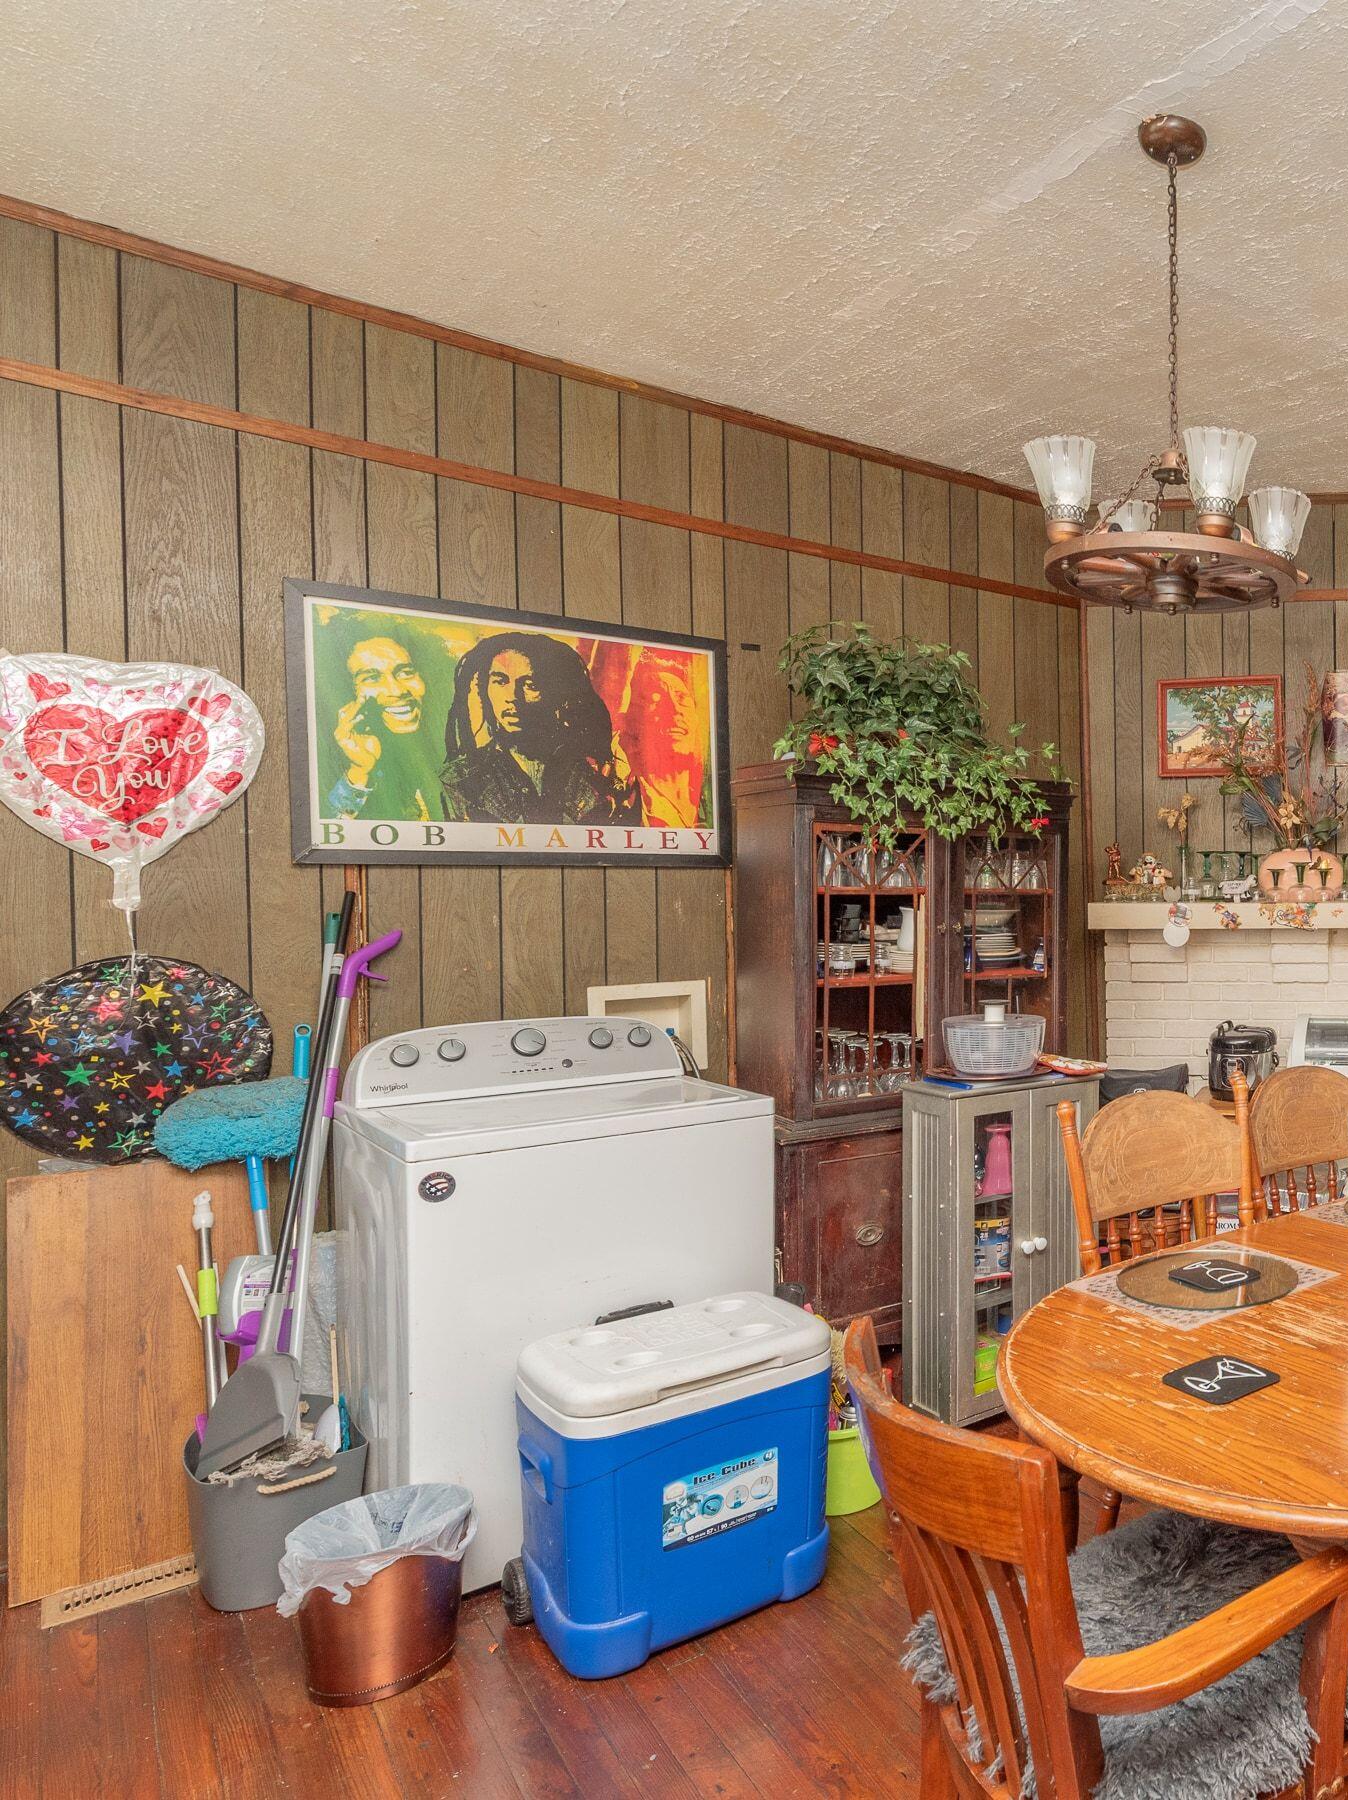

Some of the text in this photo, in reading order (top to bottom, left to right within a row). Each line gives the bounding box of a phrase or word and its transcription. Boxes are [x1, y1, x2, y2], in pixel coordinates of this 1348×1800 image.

[43, 718, 208, 768] I Love
[73, 764, 170, 812] You
[320, 823, 715, 850] BOB MARLEY
[370, 1083, 409, 1094] Whirlpool
[1217, 1222, 1240, 1230] ROM
[693, 1459, 756, 1485] Ice Cube
